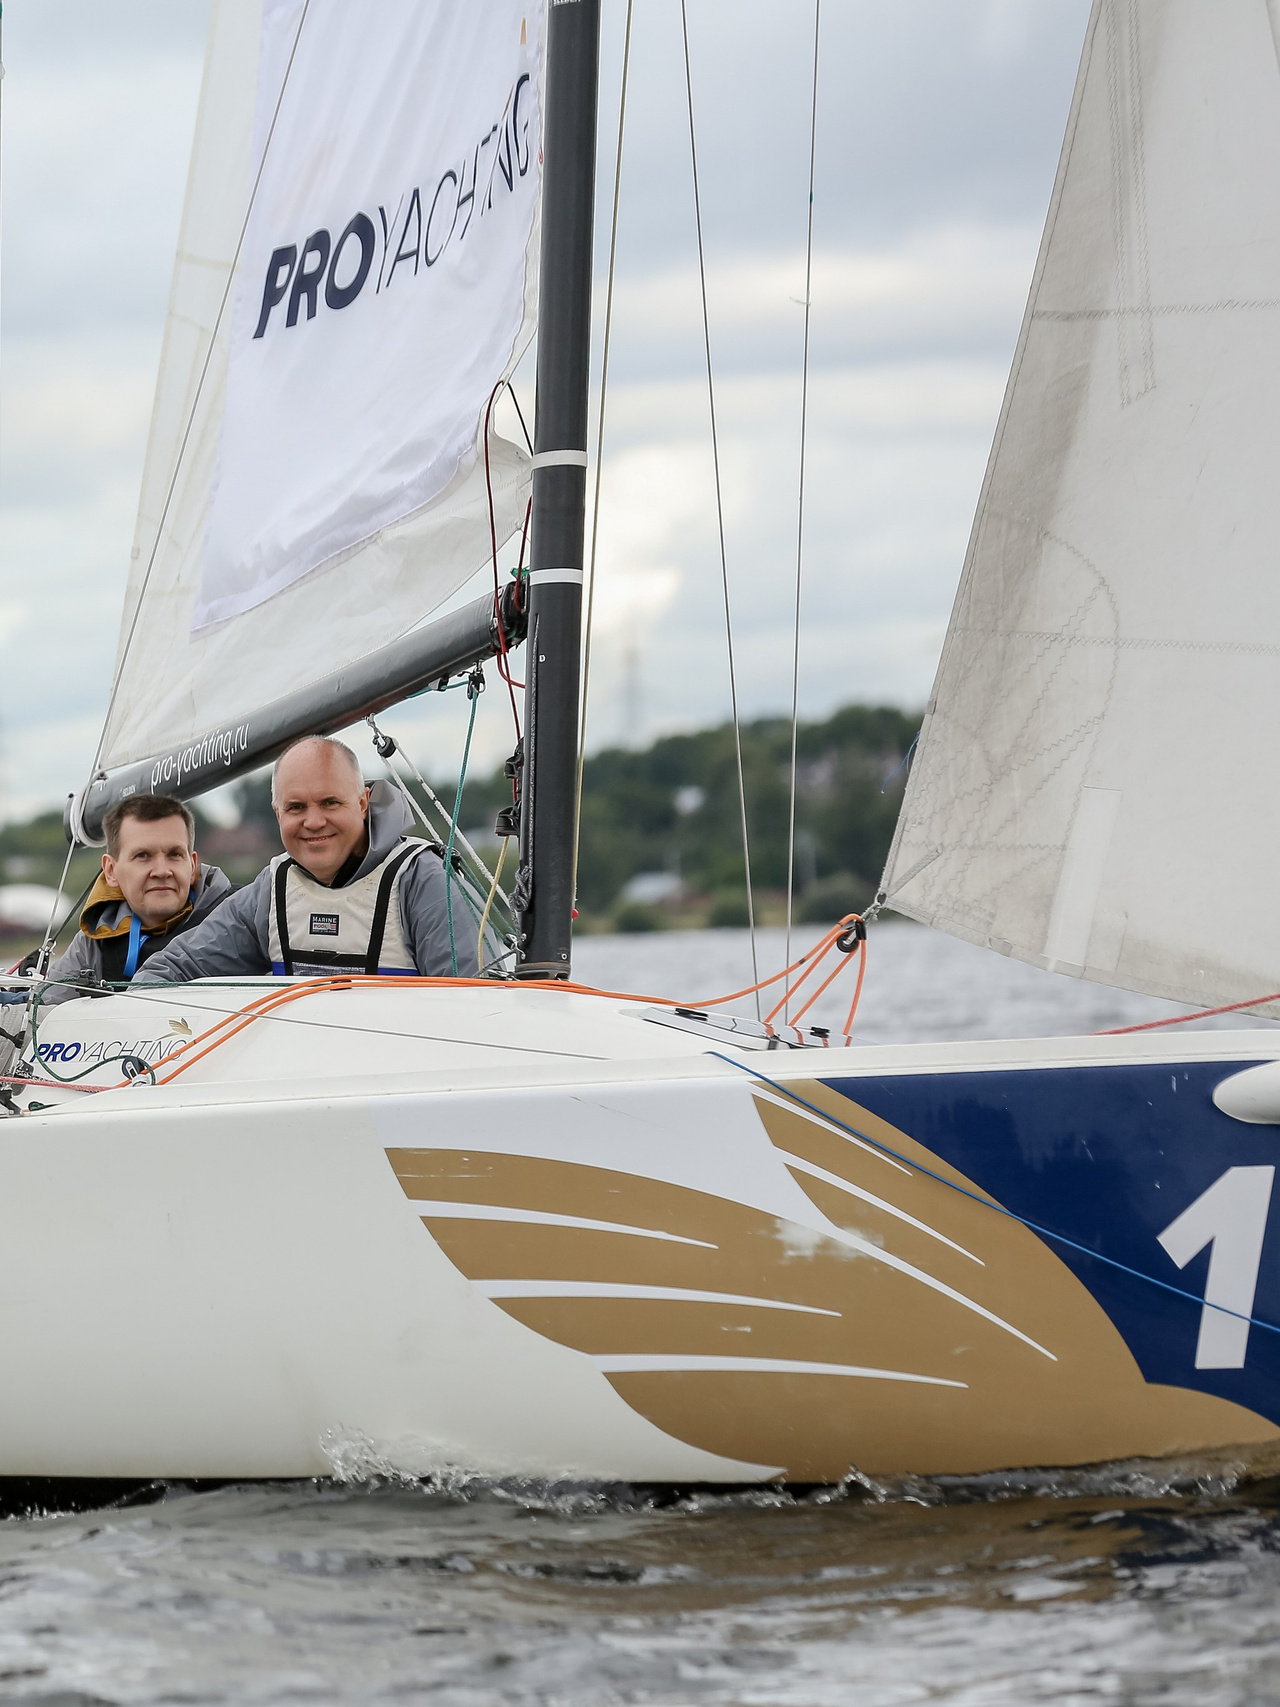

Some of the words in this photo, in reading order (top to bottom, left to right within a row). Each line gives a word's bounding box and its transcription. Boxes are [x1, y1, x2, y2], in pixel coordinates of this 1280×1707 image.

[150, 723, 250, 795] pro-yachting.ru
[29, 1039, 187, 1063] PROYACHTING
[1157, 1166, 1275, 1369] 1
